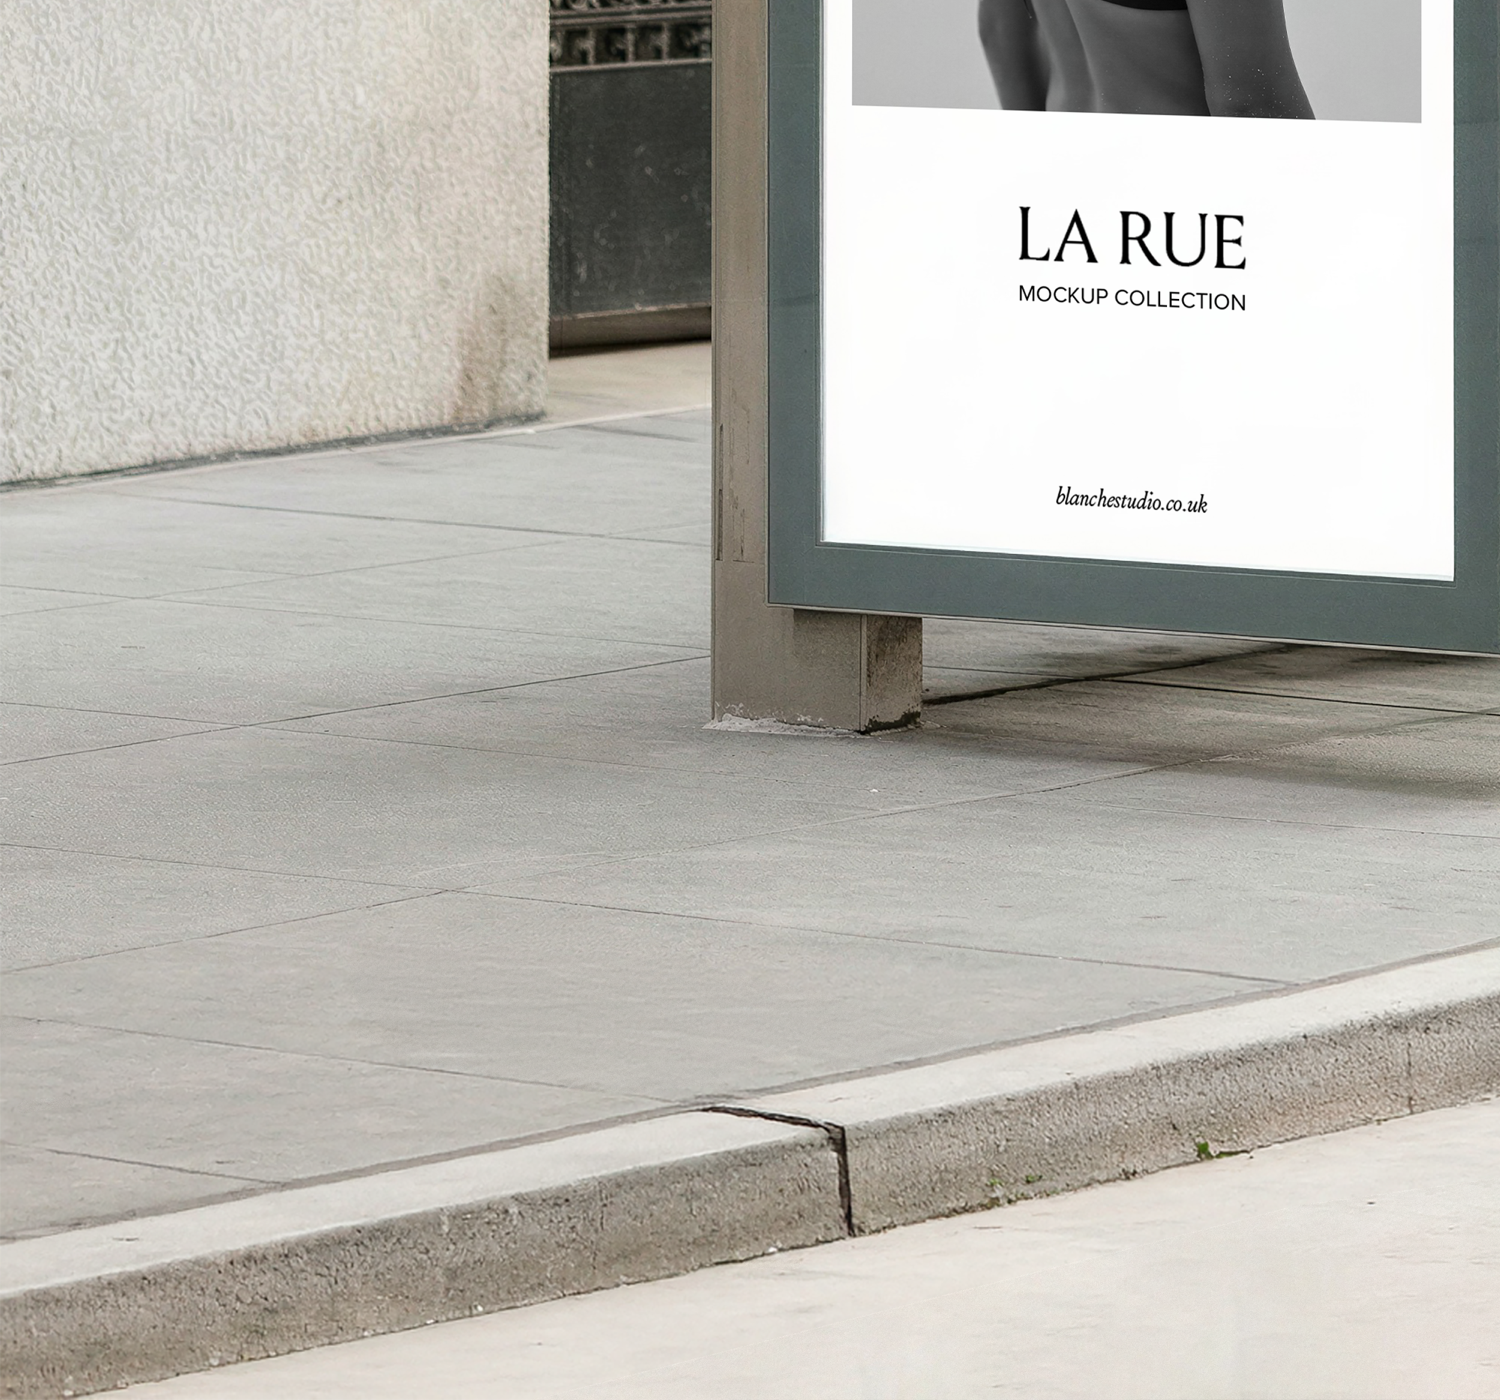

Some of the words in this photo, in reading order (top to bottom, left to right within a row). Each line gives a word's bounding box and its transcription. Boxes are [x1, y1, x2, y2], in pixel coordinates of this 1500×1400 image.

[1018, 206, 1099, 264] LA
[1119, 210, 1247, 270] RUE
[1019, 284, 1109, 305] MOCKUP
[1114, 288, 1247, 311] COLLECTION
[1055, 485, 1208, 514] blanchestudio.co.uk
